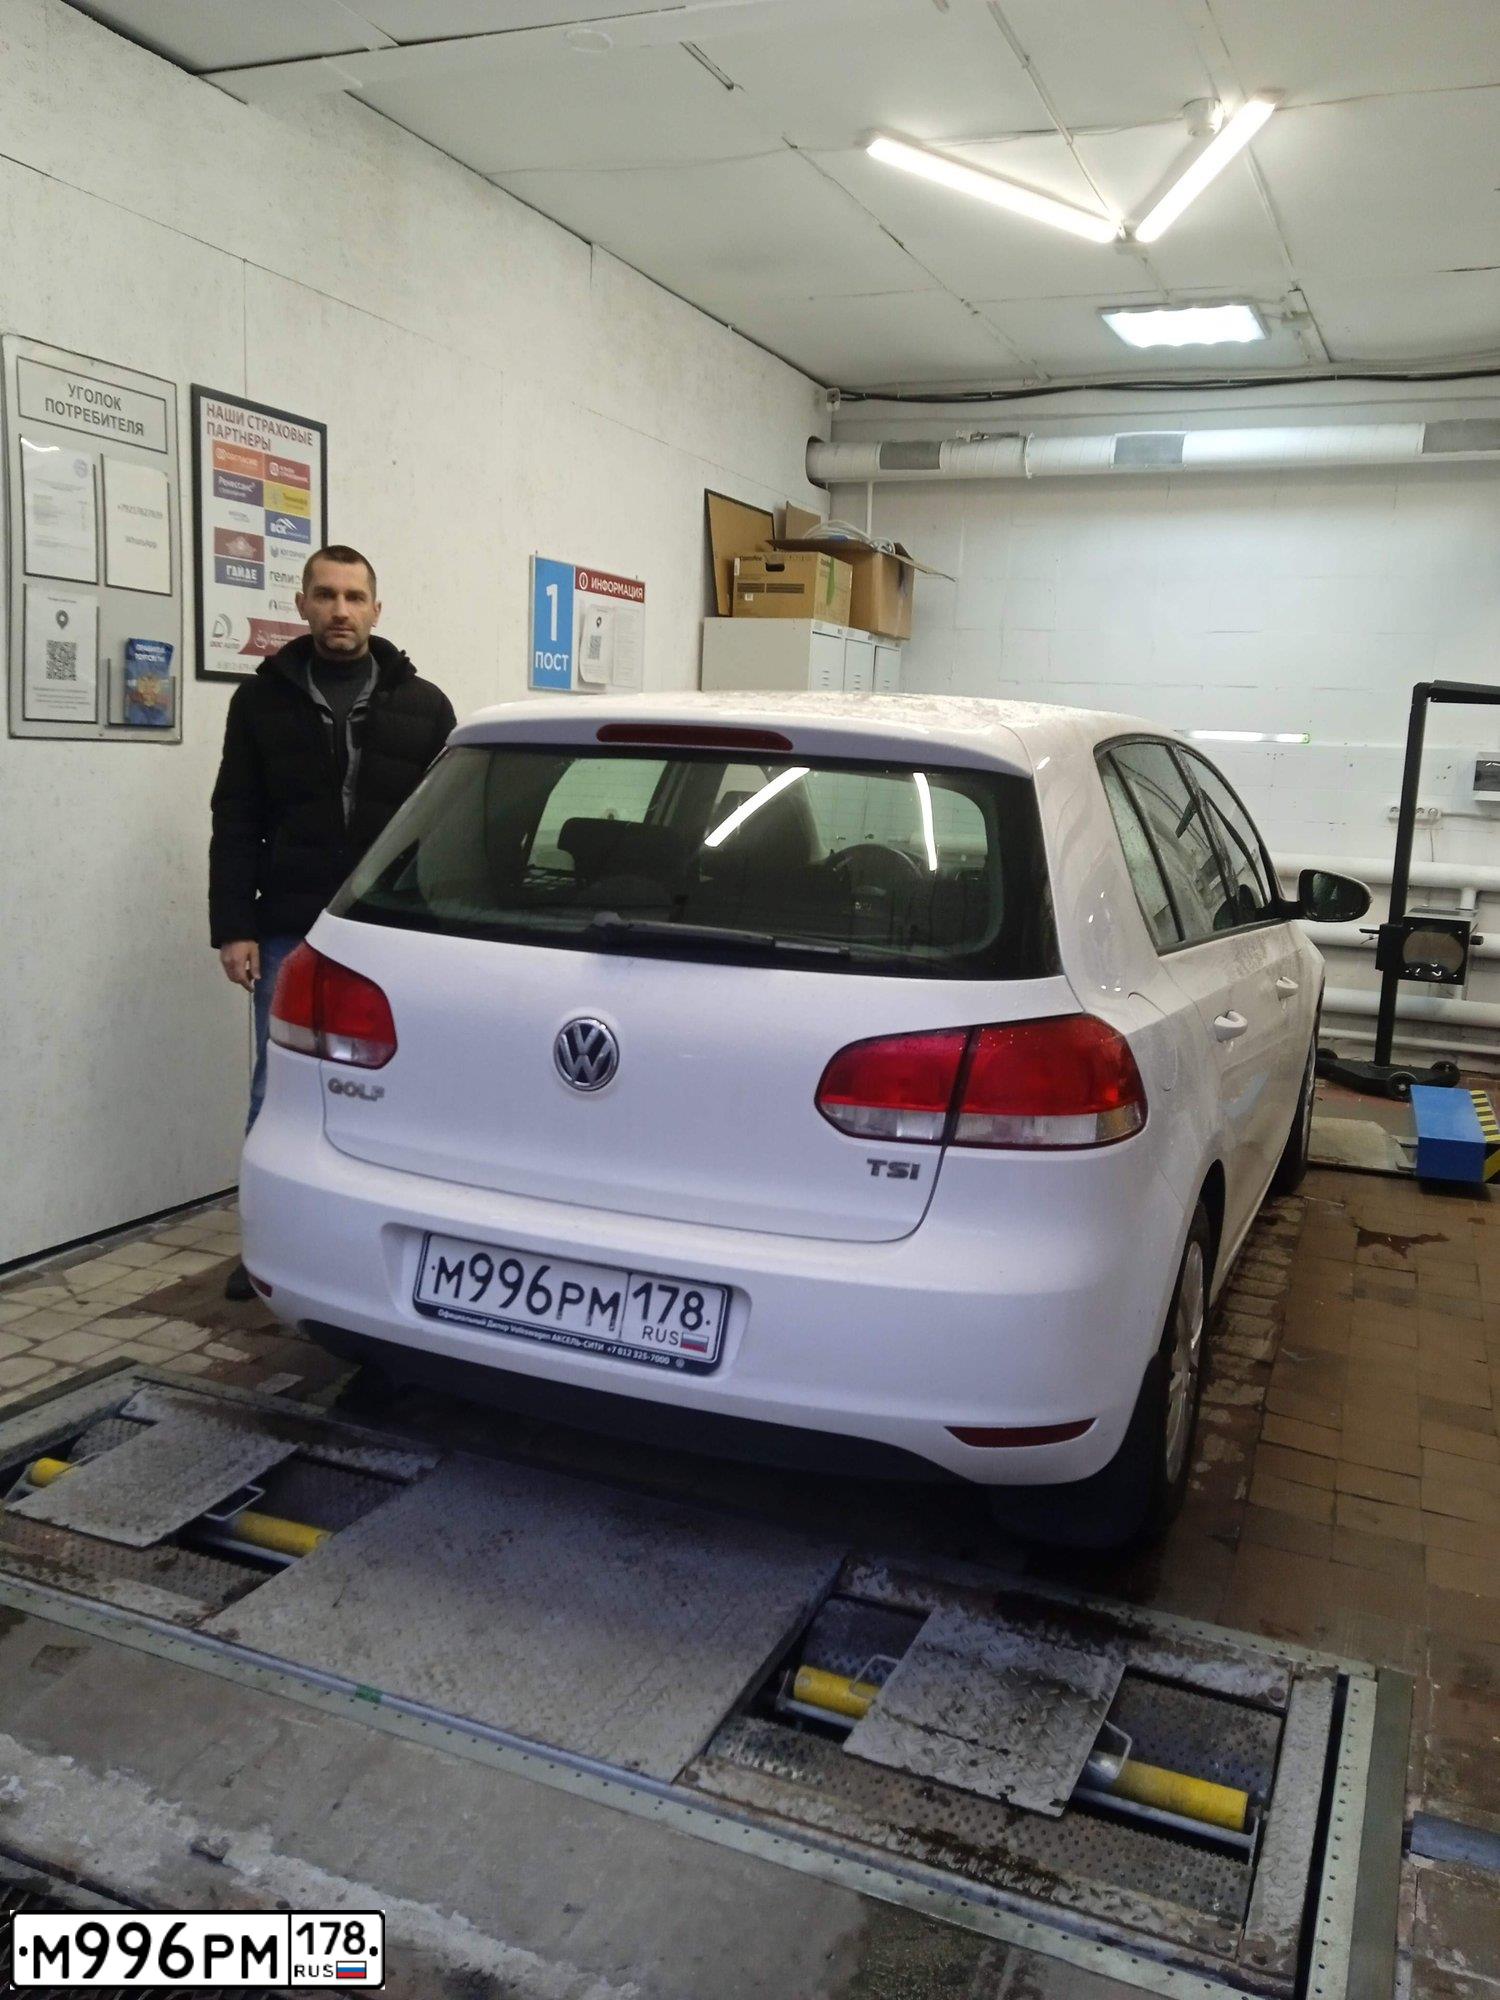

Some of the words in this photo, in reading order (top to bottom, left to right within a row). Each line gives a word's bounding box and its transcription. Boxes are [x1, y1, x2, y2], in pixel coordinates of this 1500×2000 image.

[67, 382, 122, 411] УГОЛОК
[45, 397, 145, 436] ПОТРЕБИТЕЛЯ
[206, 402, 245, 427] НАШИ
[247, 415, 313, 446] СТРАХОВЫЕ
[206, 421, 271, 452] ПАРТНЕРЫ
[590, 577, 643, 599] ИНФОРМАЦИЯ
[546, 583, 558, 641] 1
[535, 651, 569, 672] ПОСТ
[327, 1077, 385, 1101] GOLF
[867, 1158, 921, 1180] TSI
[632, 1282, 704, 1331] 178
[438, 1308, 486, 1326] Официальный
[510, 1325, 551, 1341] Volkswagen
[551, 1333, 604, 1351] АКСЕЛЬ-СИТИ
[606, 1346, 617, 1355] +7
[617, 1347, 632, 1357] 812
[642, 1325, 679, 1346] RUS
